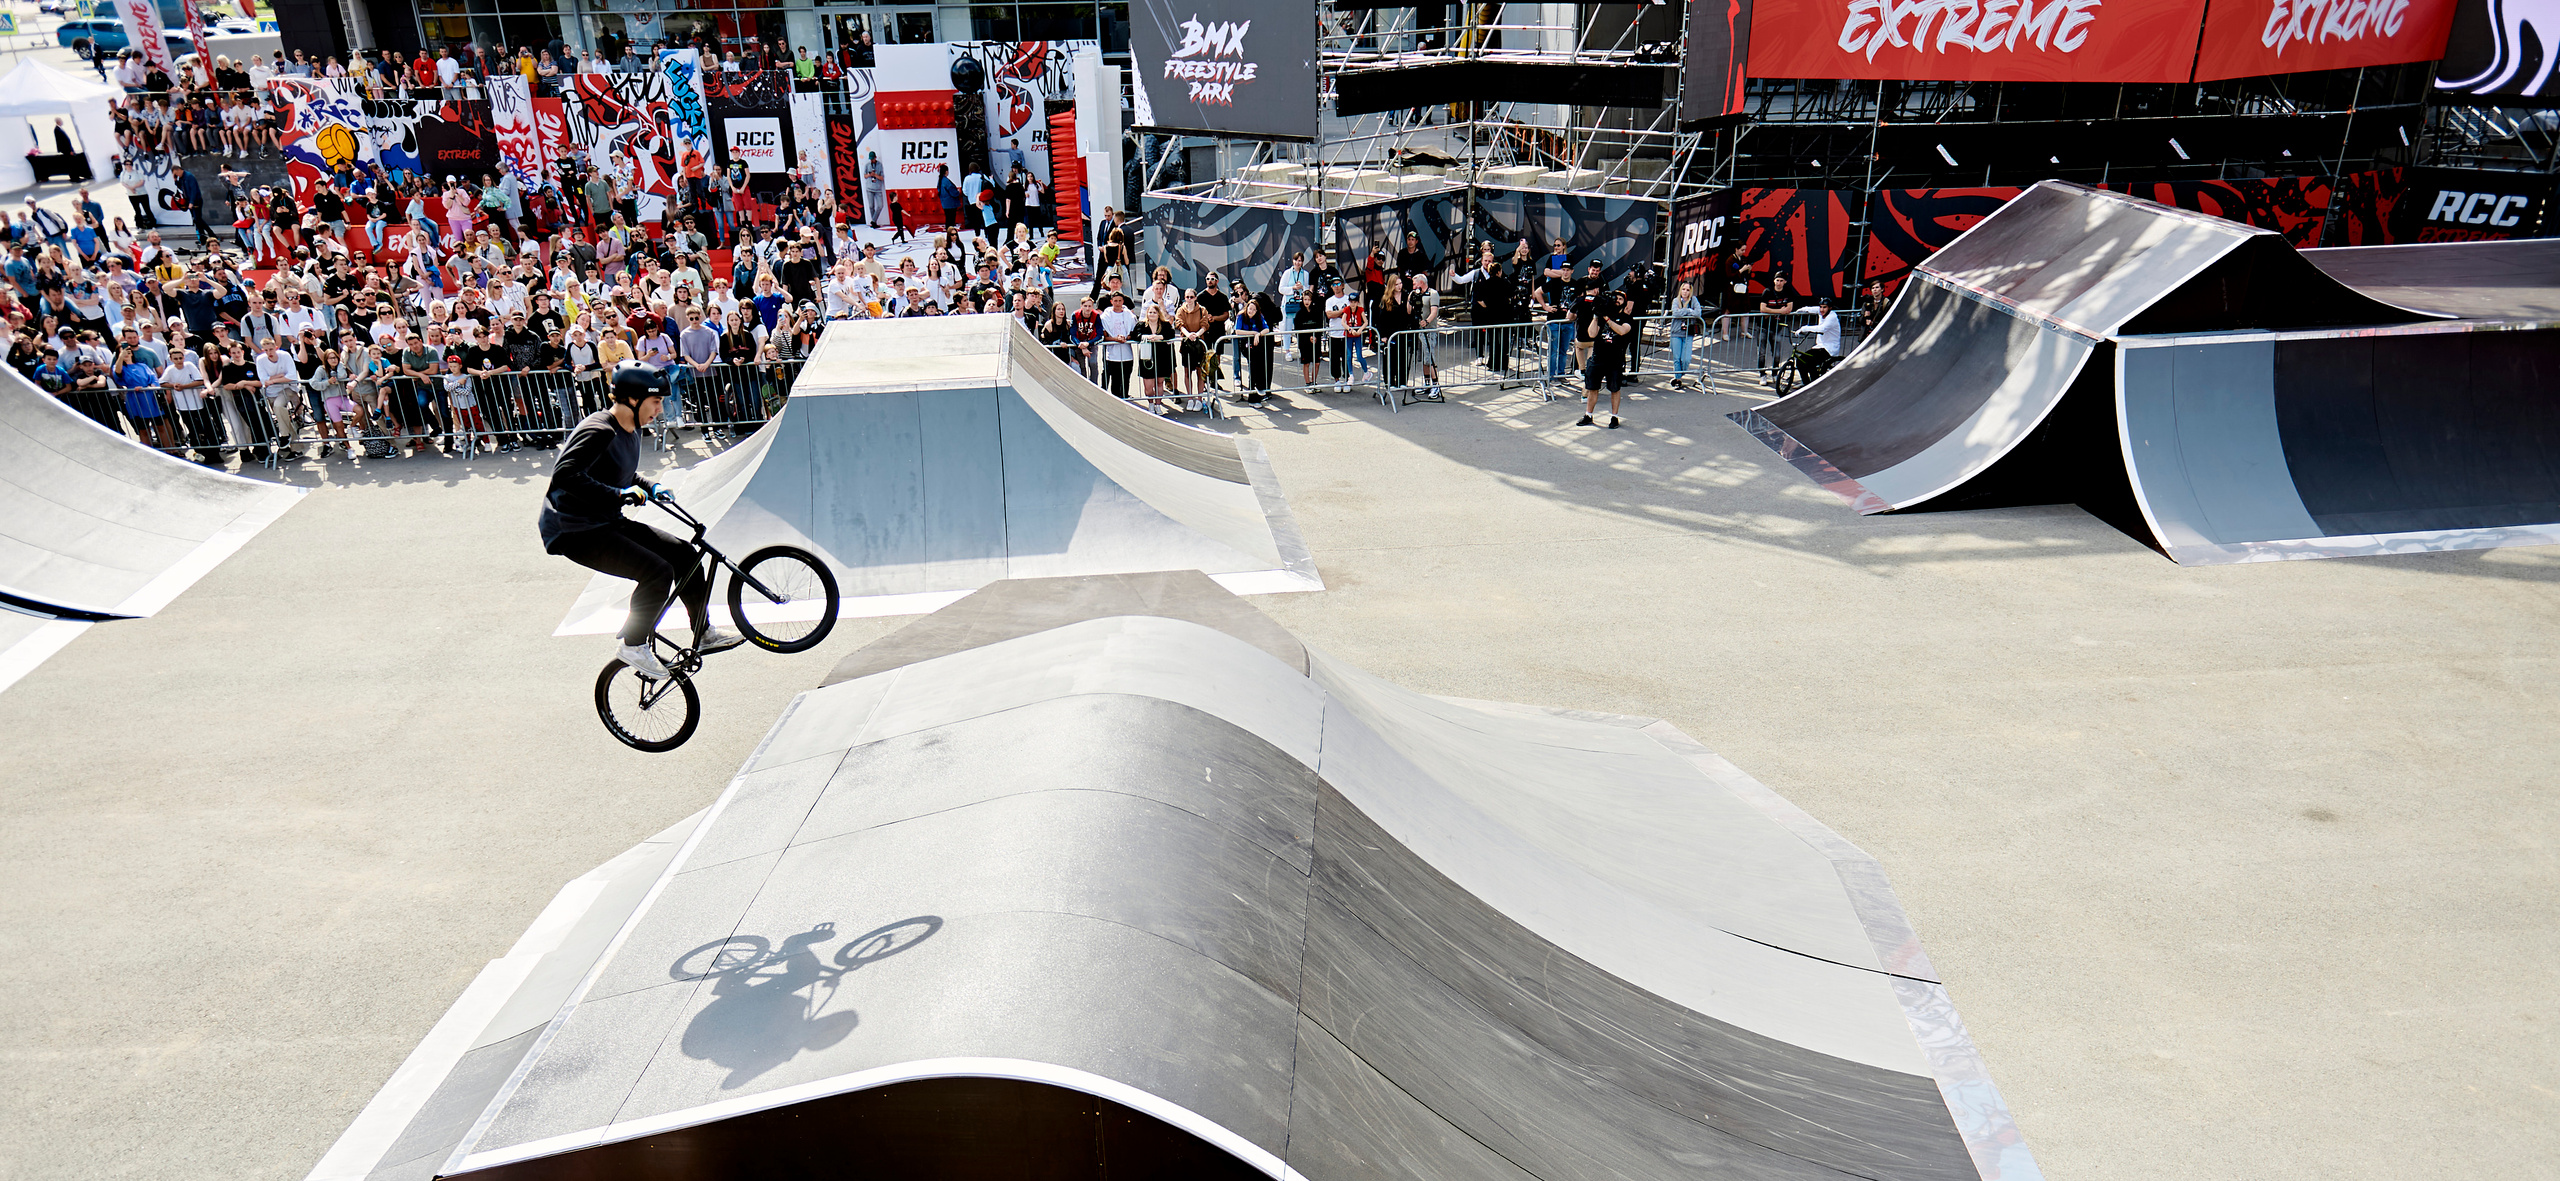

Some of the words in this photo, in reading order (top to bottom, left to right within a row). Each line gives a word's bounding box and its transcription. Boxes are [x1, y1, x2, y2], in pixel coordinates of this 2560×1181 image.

[128, 1, 169, 73] XTREME
[1171, 13, 1251, 60] BMX
[1838, 0, 2102, 64] EXTREME
[2261, 0, 2410, 59] EXTREME
[1163, 59, 1259, 84] FREESTYLE
[664, 58, 708, 139] LUCKY
[1188, 80, 1234, 106] PARK
[437, 149, 482, 160] EXTREME
[736, 131, 775, 146] RCC
[740, 148, 775, 158] XTREME
[901, 141, 948, 160] RCC
[831, 120, 865, 220] EXTREME
[2427, 190, 2528, 227] RCC
[1681, 216, 1725, 257] RCC
[1678, 253, 1719, 282] EXTREME
